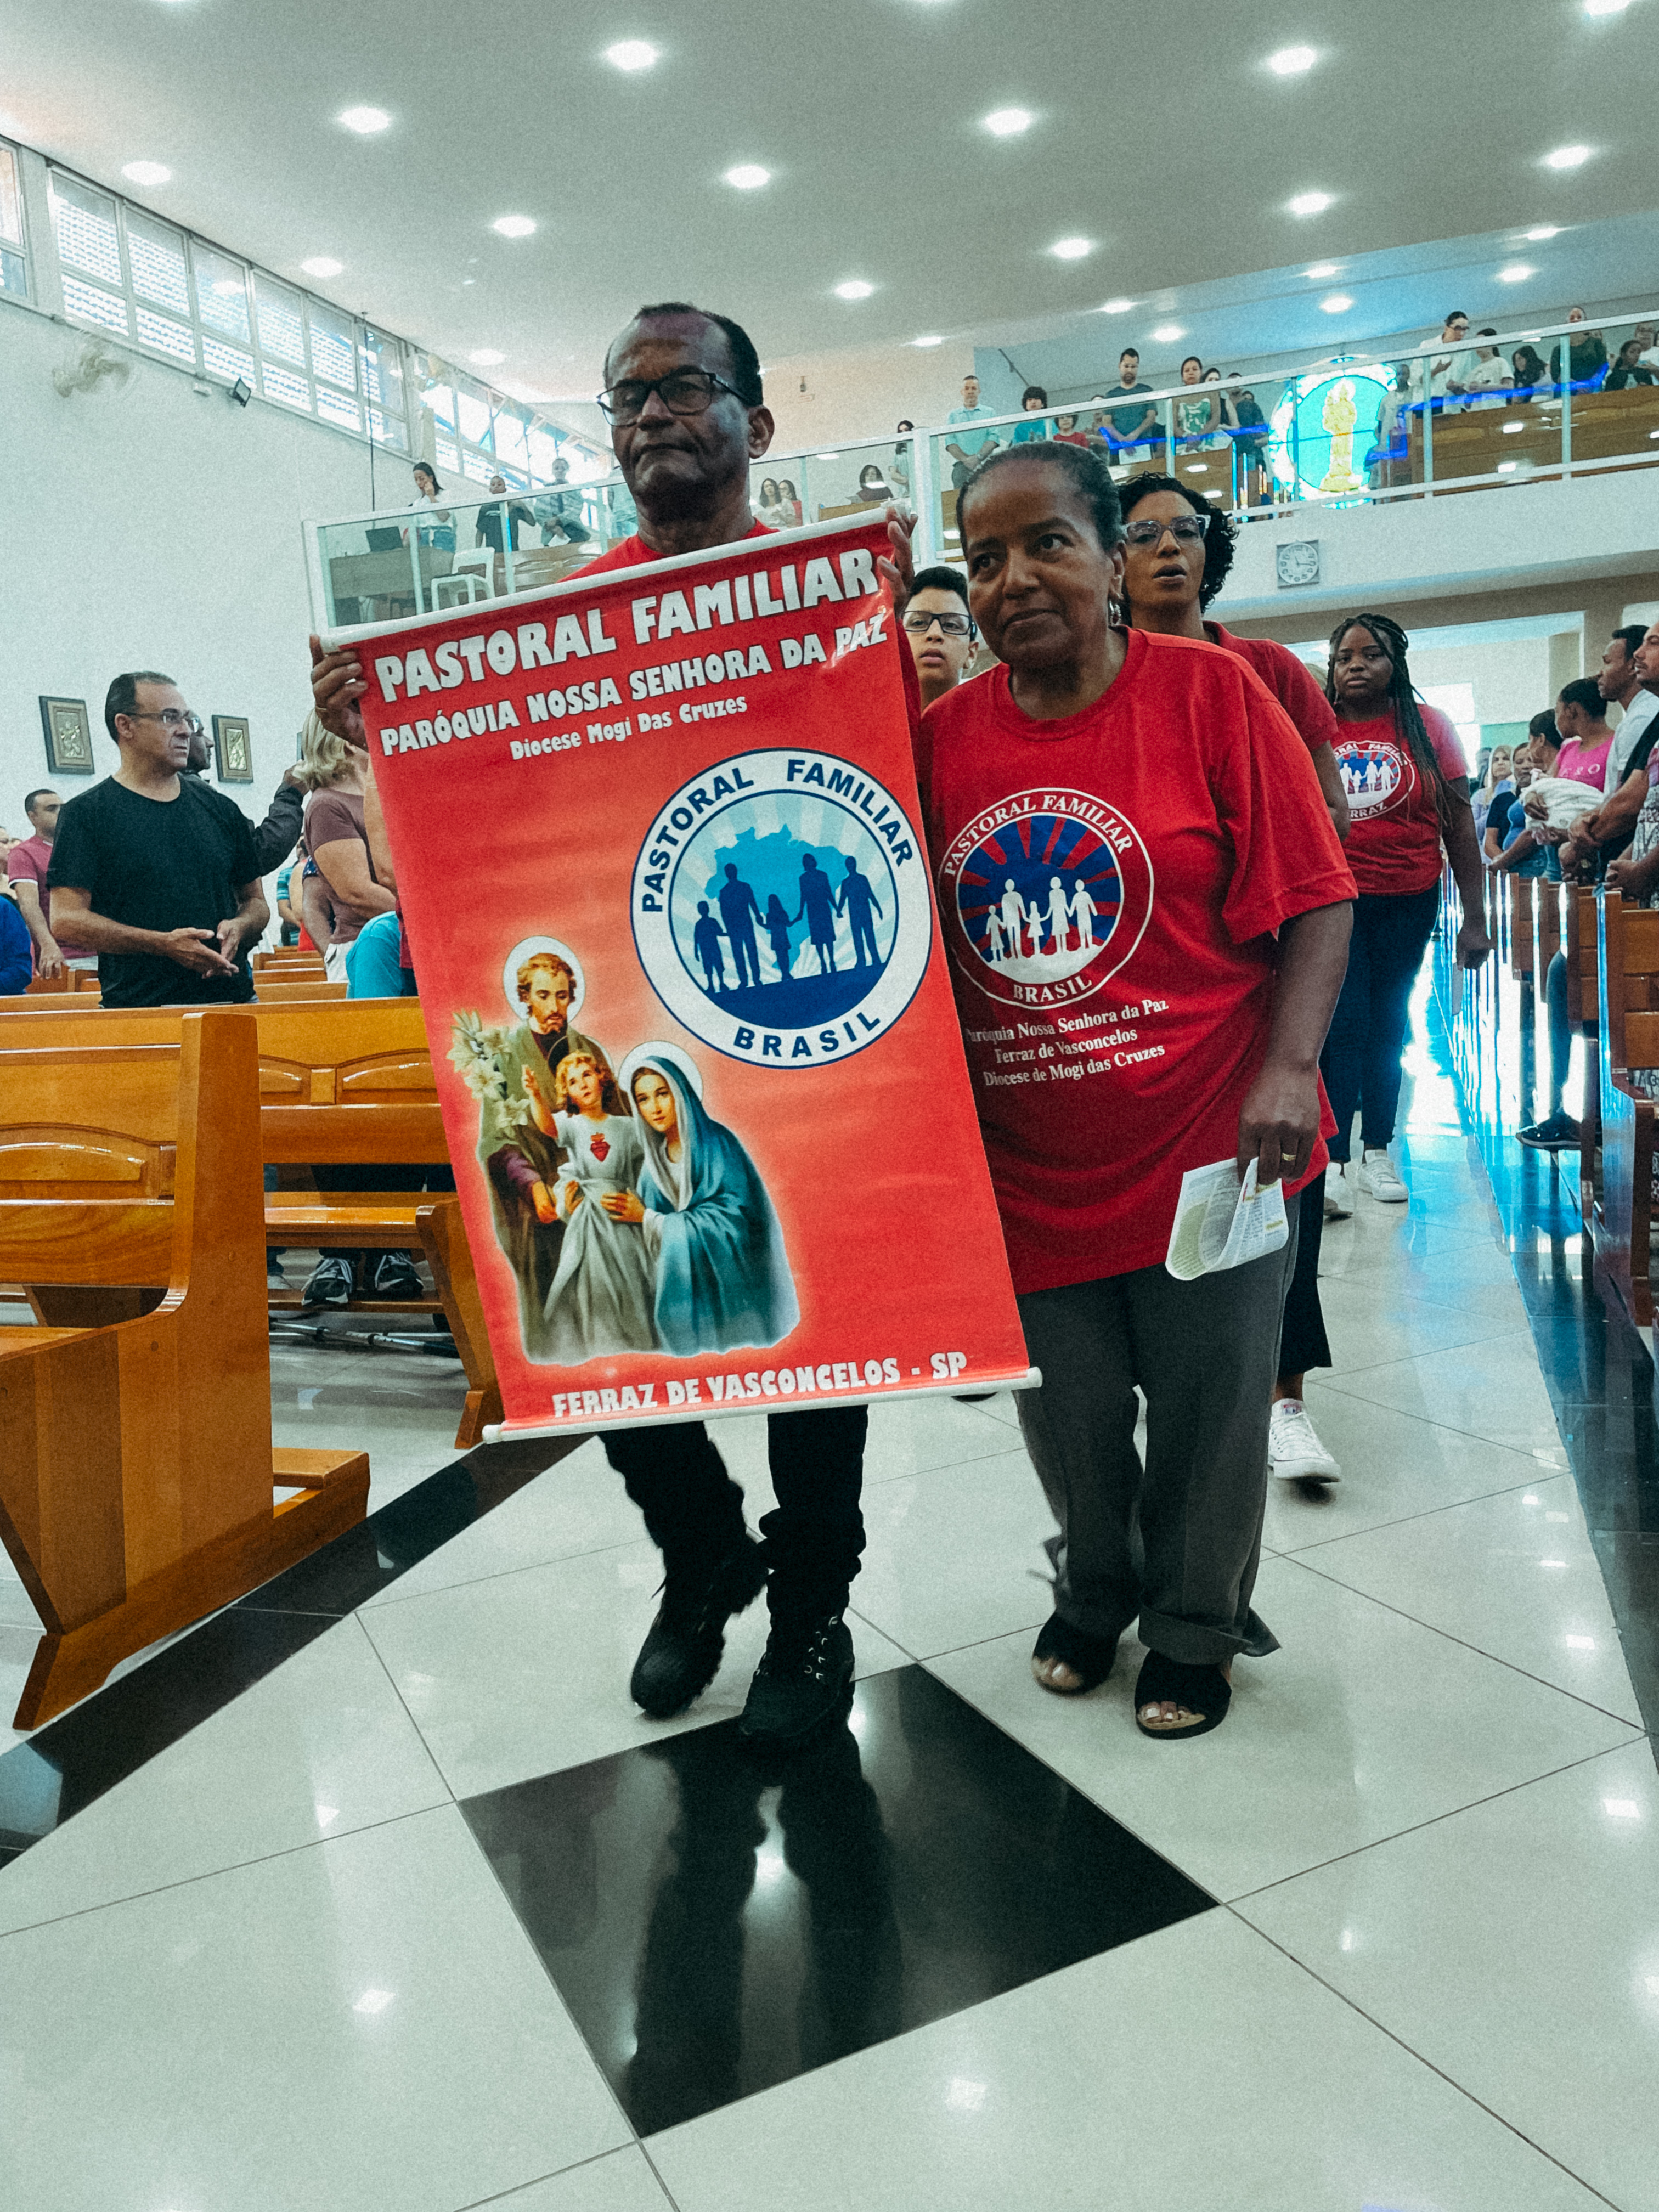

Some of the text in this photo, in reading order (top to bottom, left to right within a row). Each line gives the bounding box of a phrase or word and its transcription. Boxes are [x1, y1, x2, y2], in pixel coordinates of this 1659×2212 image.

[375, 548, 879, 702] PASTORAL FAMILIAR
[380, 610, 888, 755] PARÓQUIA NOSSA SENHORA DA PAZ
[510, 695, 748, 760] Diocese Mogi Das Cruzes
[642, 759, 913, 912] PASTORAL FAMILIAR
[945, 795, 1133, 876] PASTORAL FAMILIAR
[1350, 801, 1387, 818] RRAZ
[1012, 975, 1092, 1003] BRASIL
[733, 1012, 881, 1058] BRASIL
[995, 1028, 1138, 1063] Ferraz de Vasconcelos
[1017, 1021, 1055, 1041] Nossa
[1058, 1011, 1118, 1034] Senhora
[1121, 1005, 1141, 1020] da
[1142, 998, 1169, 1015] Paz
[983, 1044, 1166, 1086] Diocese de Mogi das Cruzes
[552, 1383, 658, 1418] FERRAZ
[666, 1378, 702, 1406] DE
[706, 1358, 901, 1402] VASCONCELOS
[930, 1351, 968, 1379] SP
